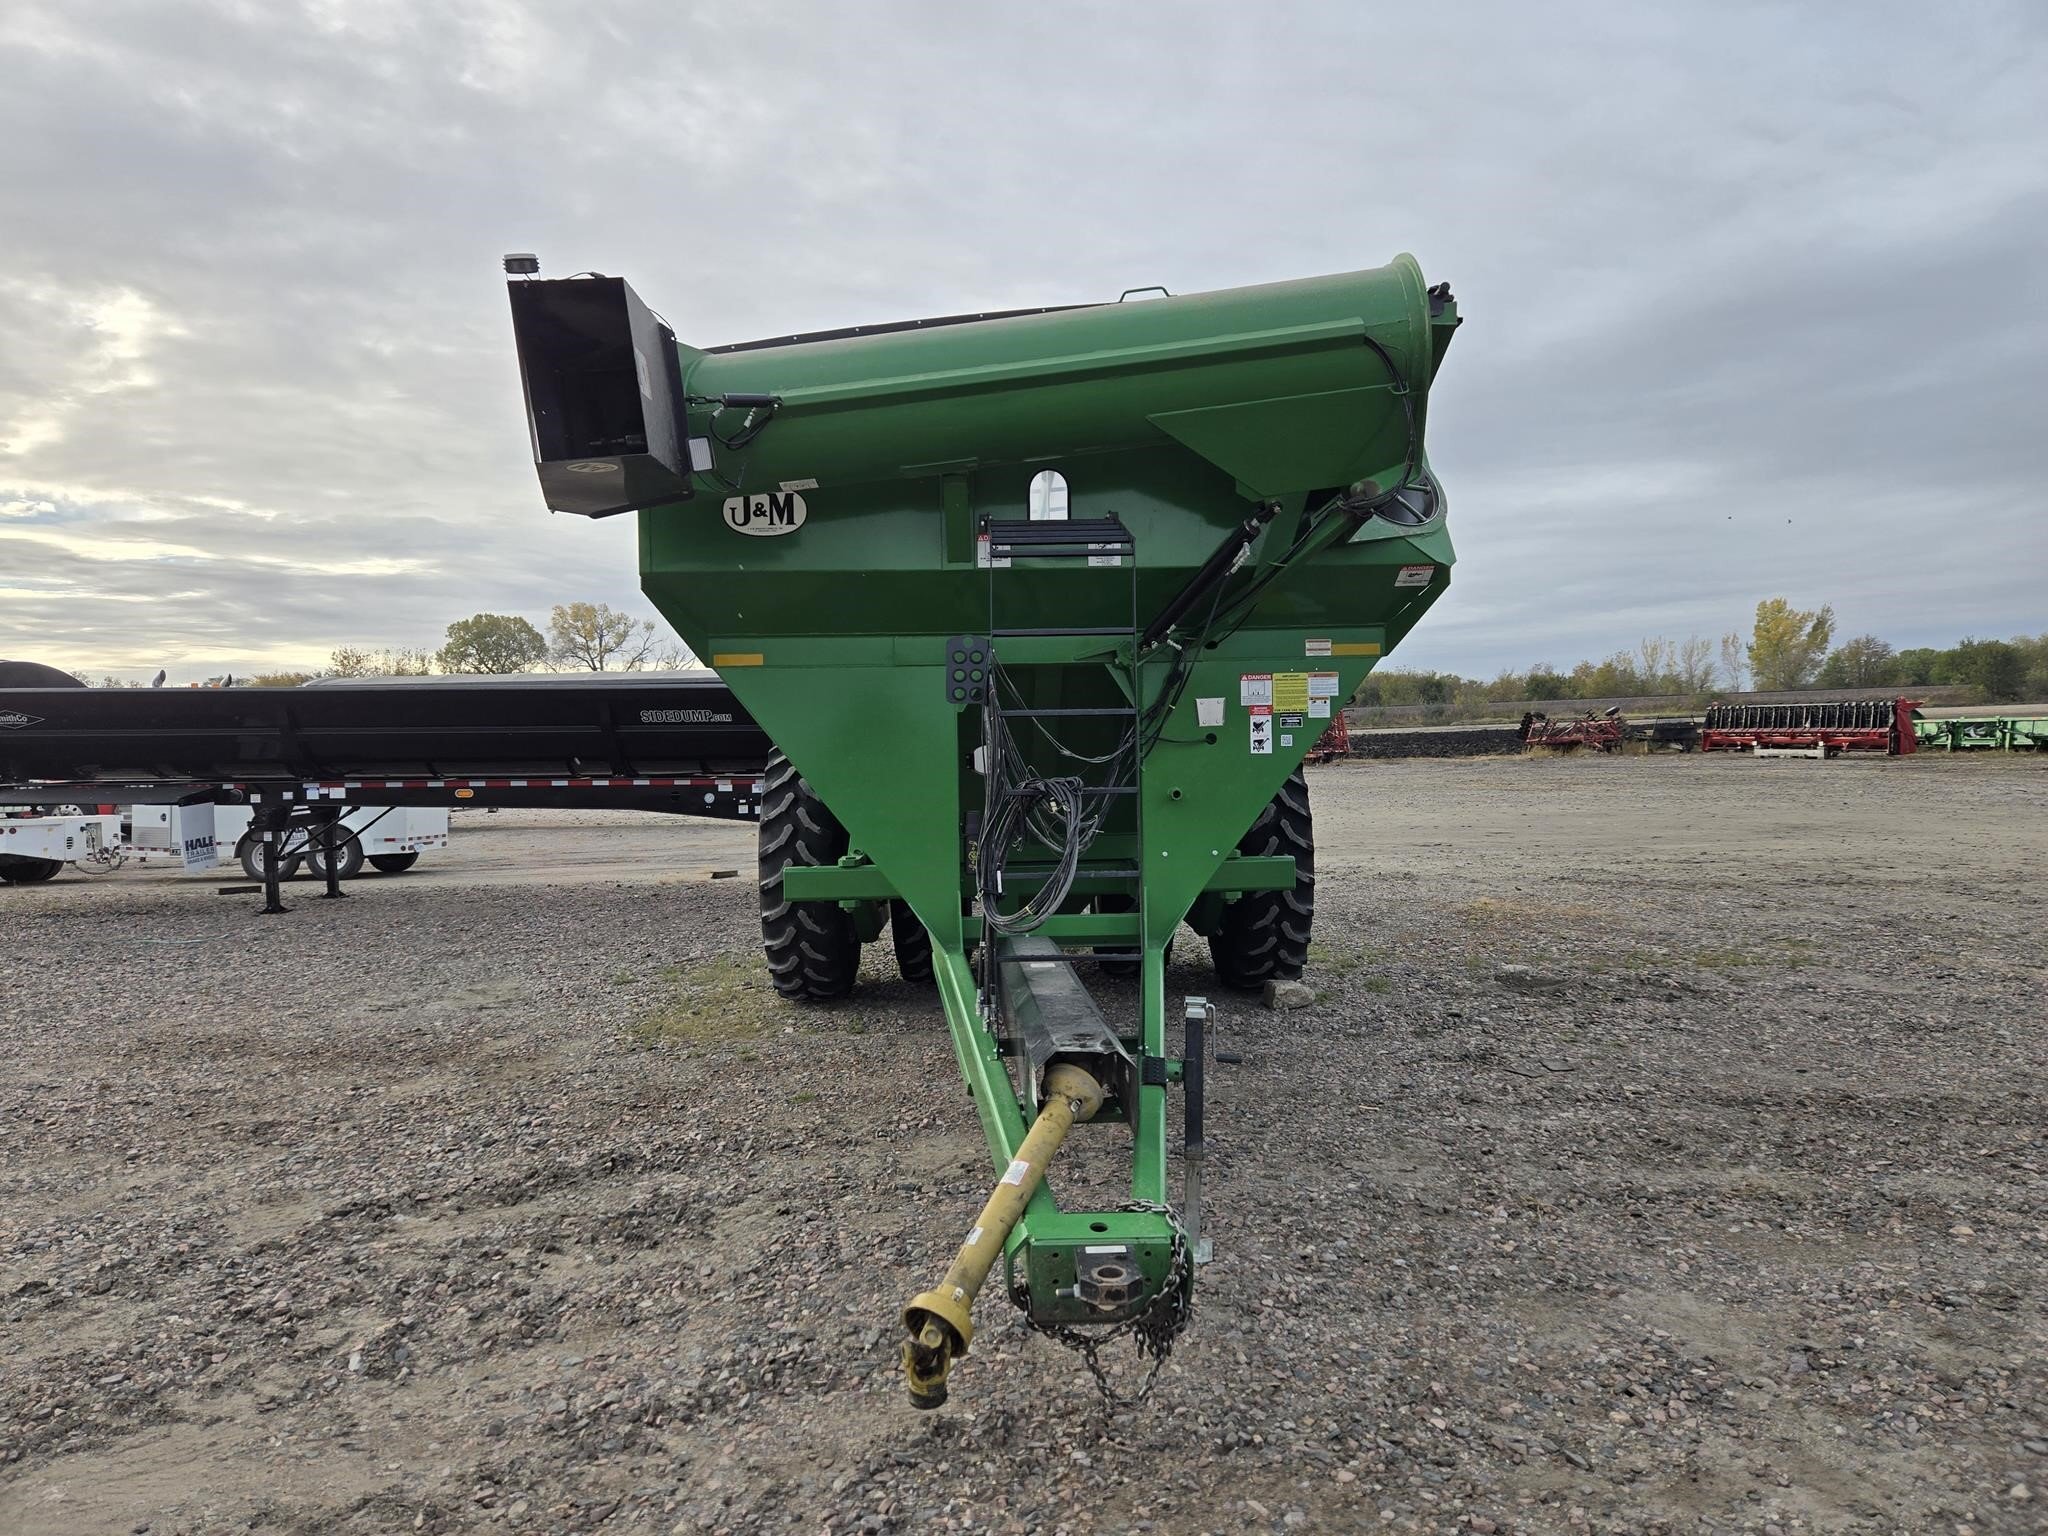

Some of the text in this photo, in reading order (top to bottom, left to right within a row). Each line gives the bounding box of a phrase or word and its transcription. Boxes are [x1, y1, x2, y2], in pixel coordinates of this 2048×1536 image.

[729, 493, 797, 527] J&M
[0, 714, 28, 722] mithCo
[184, 836, 214, 852] HALE
[186, 847, 215, 858] TRAILER
